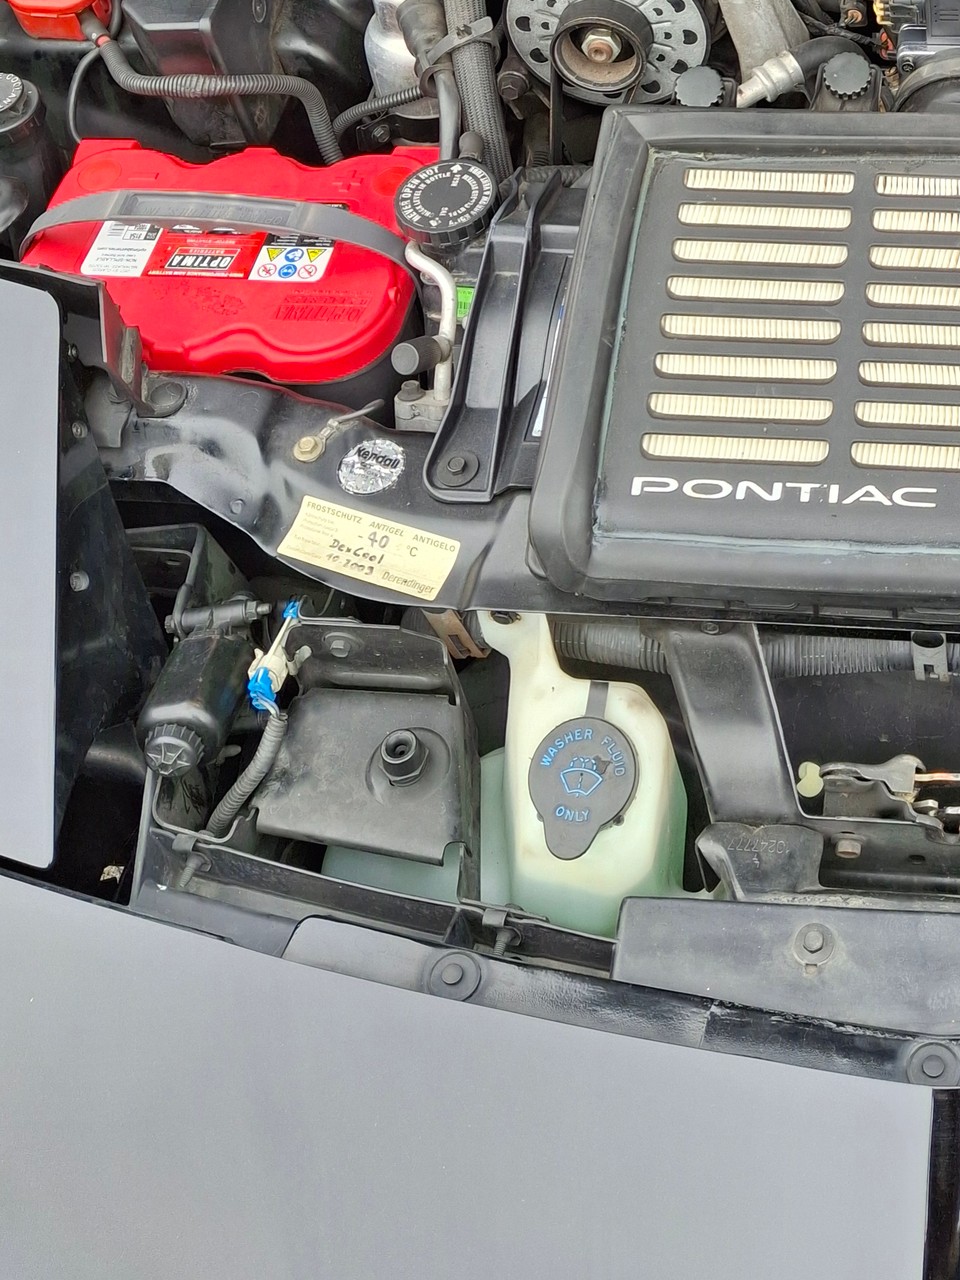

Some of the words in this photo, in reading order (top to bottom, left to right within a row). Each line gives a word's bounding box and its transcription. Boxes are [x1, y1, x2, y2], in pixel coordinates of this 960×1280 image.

[418, 166, 440, 179] HOT
[425, 171, 451, 184] BOTTLE
[401, 178, 421, 198] OPEN
[413, 190, 422, 206] LEVEL
[401, 200, 421, 222] NEVER
[415, 205, 434, 218] CHECK
[171, 255, 234, 268] OPTIMA
[356, 446, 401, 468] Kendall
[631, 476, 938, 508] PONTIAC
[307, 501, 363, 524] FROSTSCHUTZ
[369, 521, 404, 537] ANTIGEL
[412, 533, 456, 553] ANTIGELO
[406, 544, 419, 557] °C
[382, 571, 435, 594] Derendinger
[540, 728, 594, 767] WASHER
[601, 736, 626, 777] FLUID
[555, 805, 590, 823] ONLY
